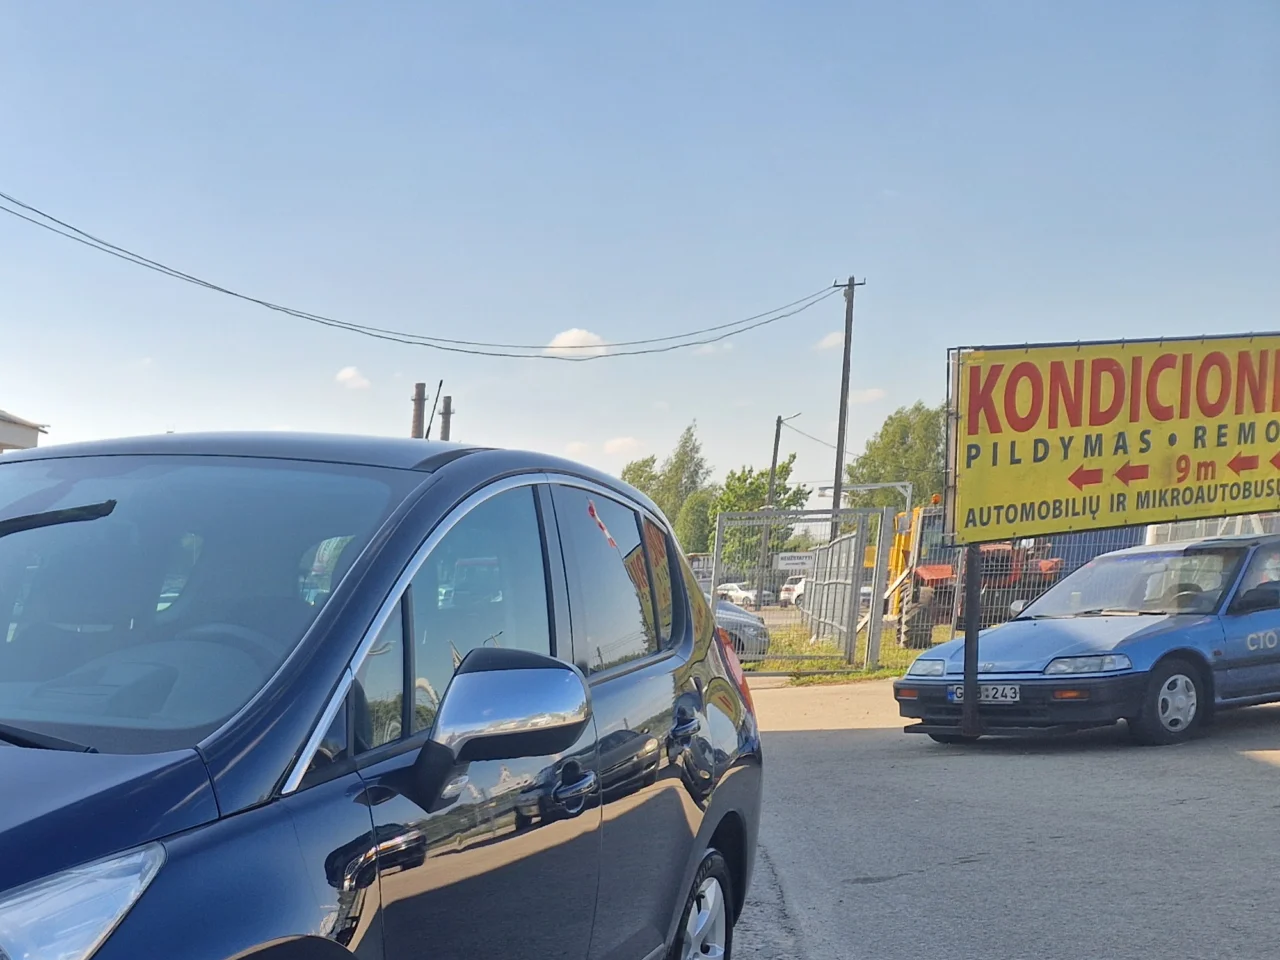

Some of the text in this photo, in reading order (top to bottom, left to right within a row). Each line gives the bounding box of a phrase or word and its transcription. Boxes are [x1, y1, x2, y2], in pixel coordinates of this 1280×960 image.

[966, 419, 1280, 469] PILDYMAS REMO
[1176, 454, 1217, 484] 9 m
[964, 494, 1101, 529] AUTOMOBILIŲ
[1109, 492, 1127, 513] IR
[991, 687, 1018, 699] 243
